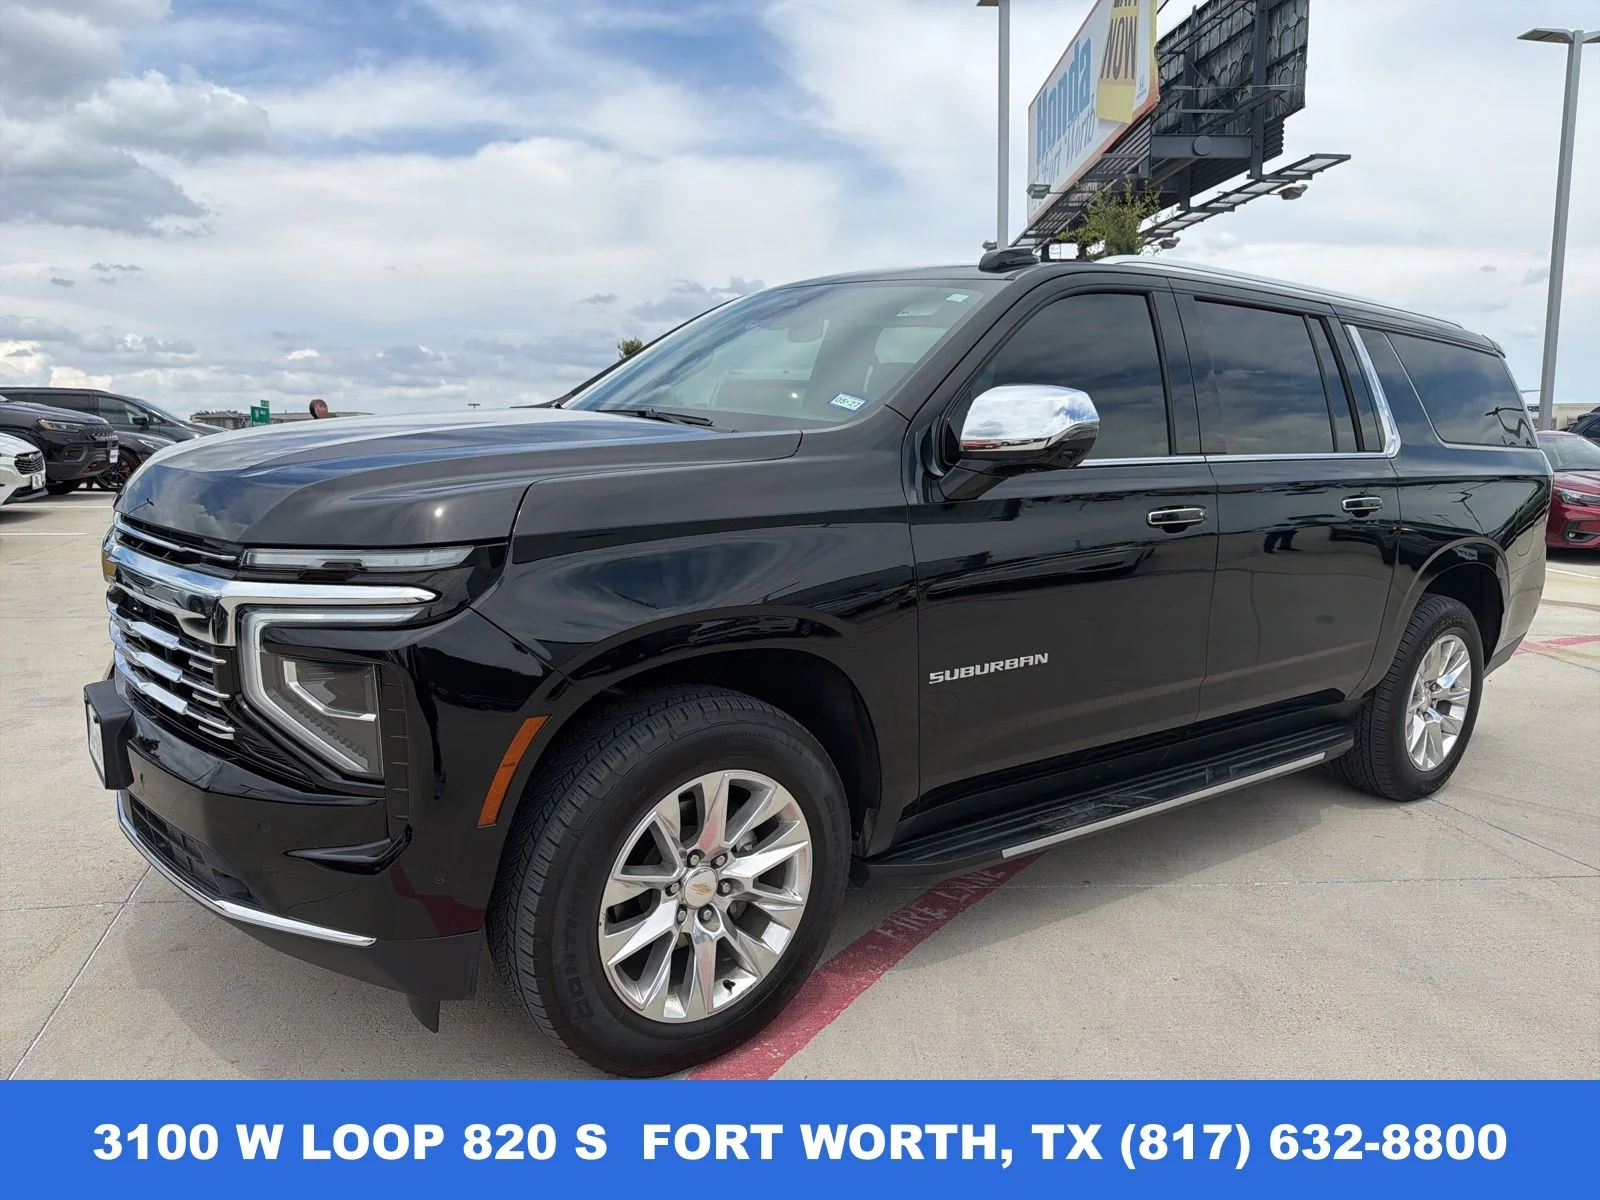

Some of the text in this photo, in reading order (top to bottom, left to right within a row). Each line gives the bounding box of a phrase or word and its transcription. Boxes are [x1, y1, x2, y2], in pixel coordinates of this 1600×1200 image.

[1100, 16, 1137, 80] NOW
[1037, 37, 1091, 166] Honda
[929, 653, 1049, 684] SUBURBAN
